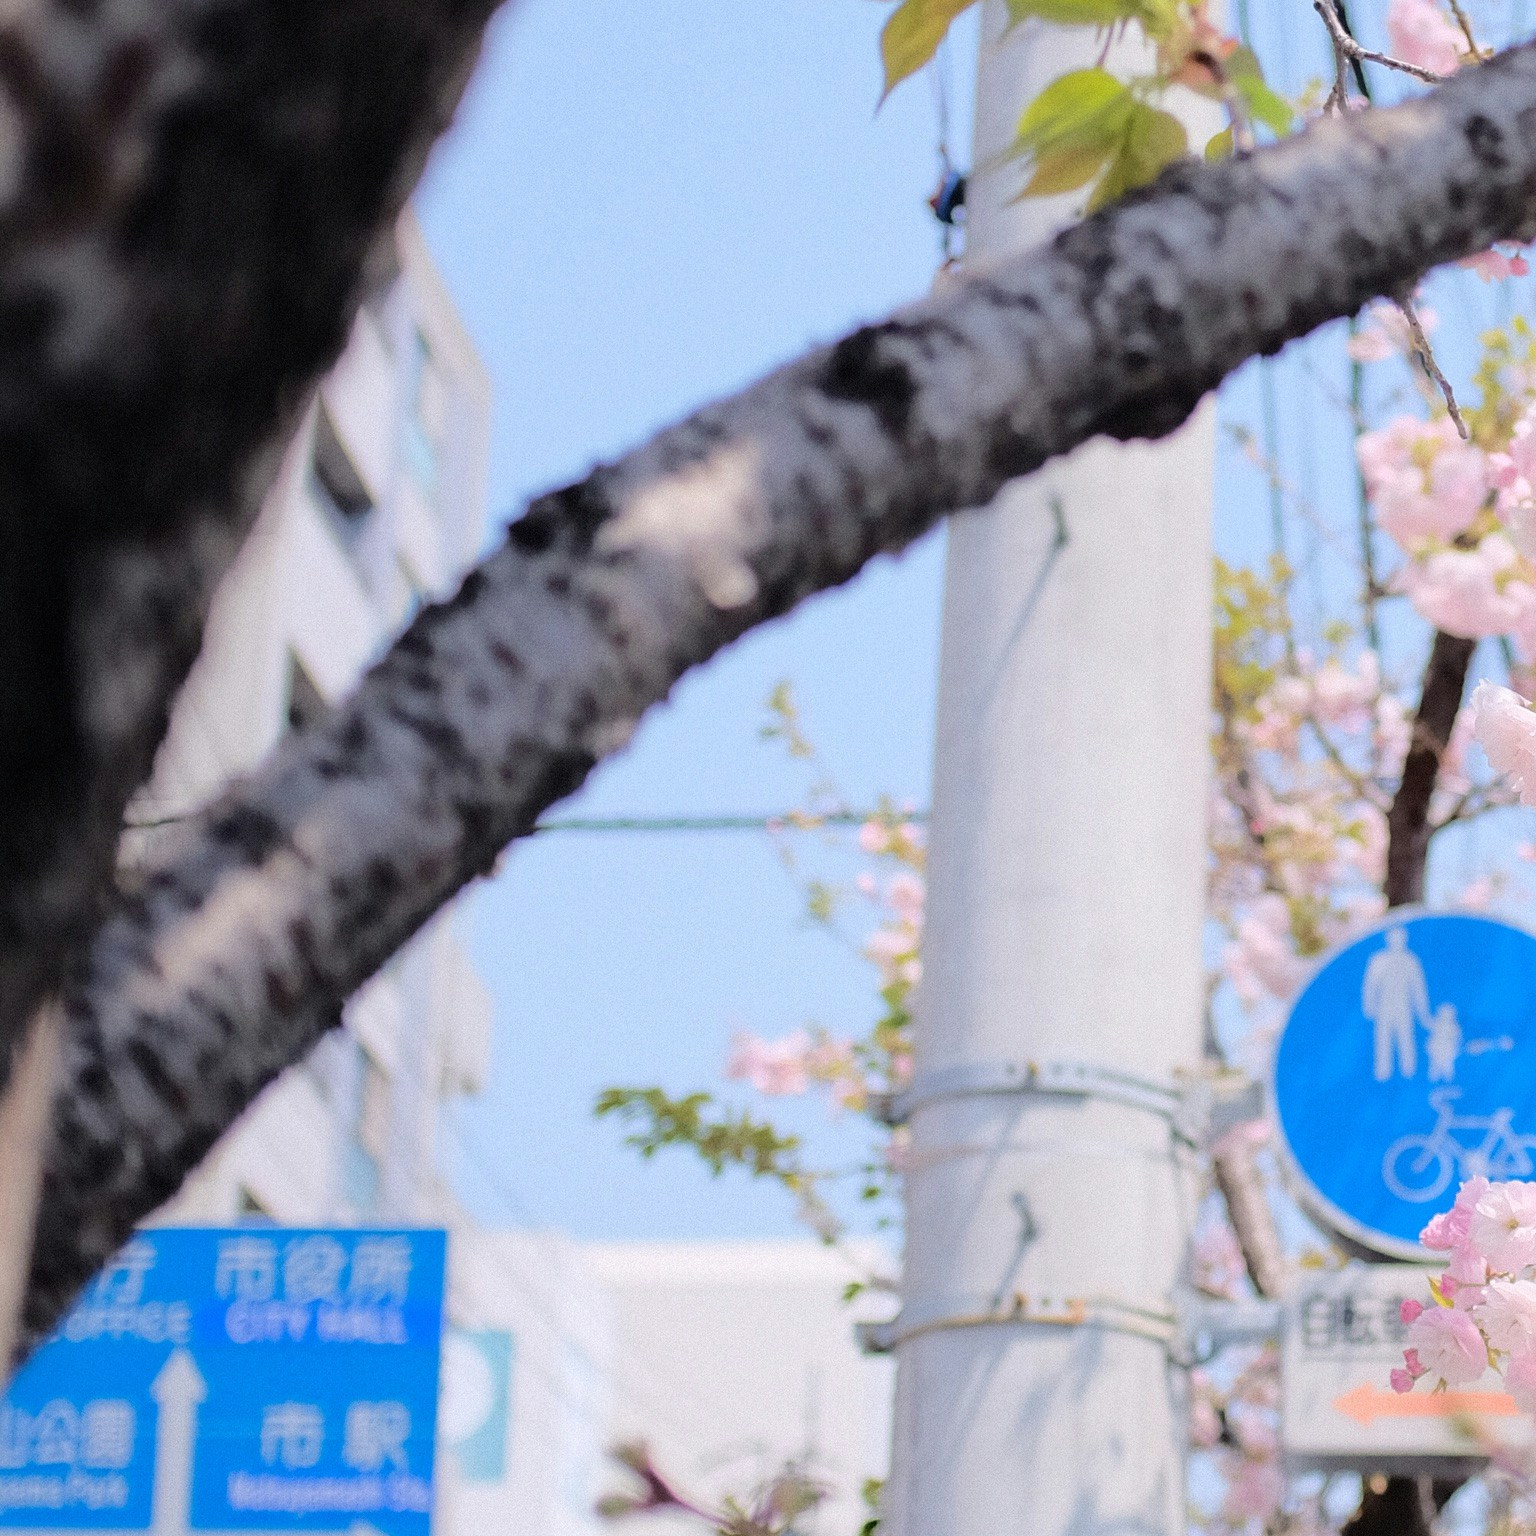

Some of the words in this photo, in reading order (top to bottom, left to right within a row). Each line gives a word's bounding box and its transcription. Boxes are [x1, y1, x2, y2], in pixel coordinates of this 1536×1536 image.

[215, 1235, 412, 1305] 市役所
[225, 1302, 308, 1343] CITY
[317, 1302, 408, 1344] HALL
